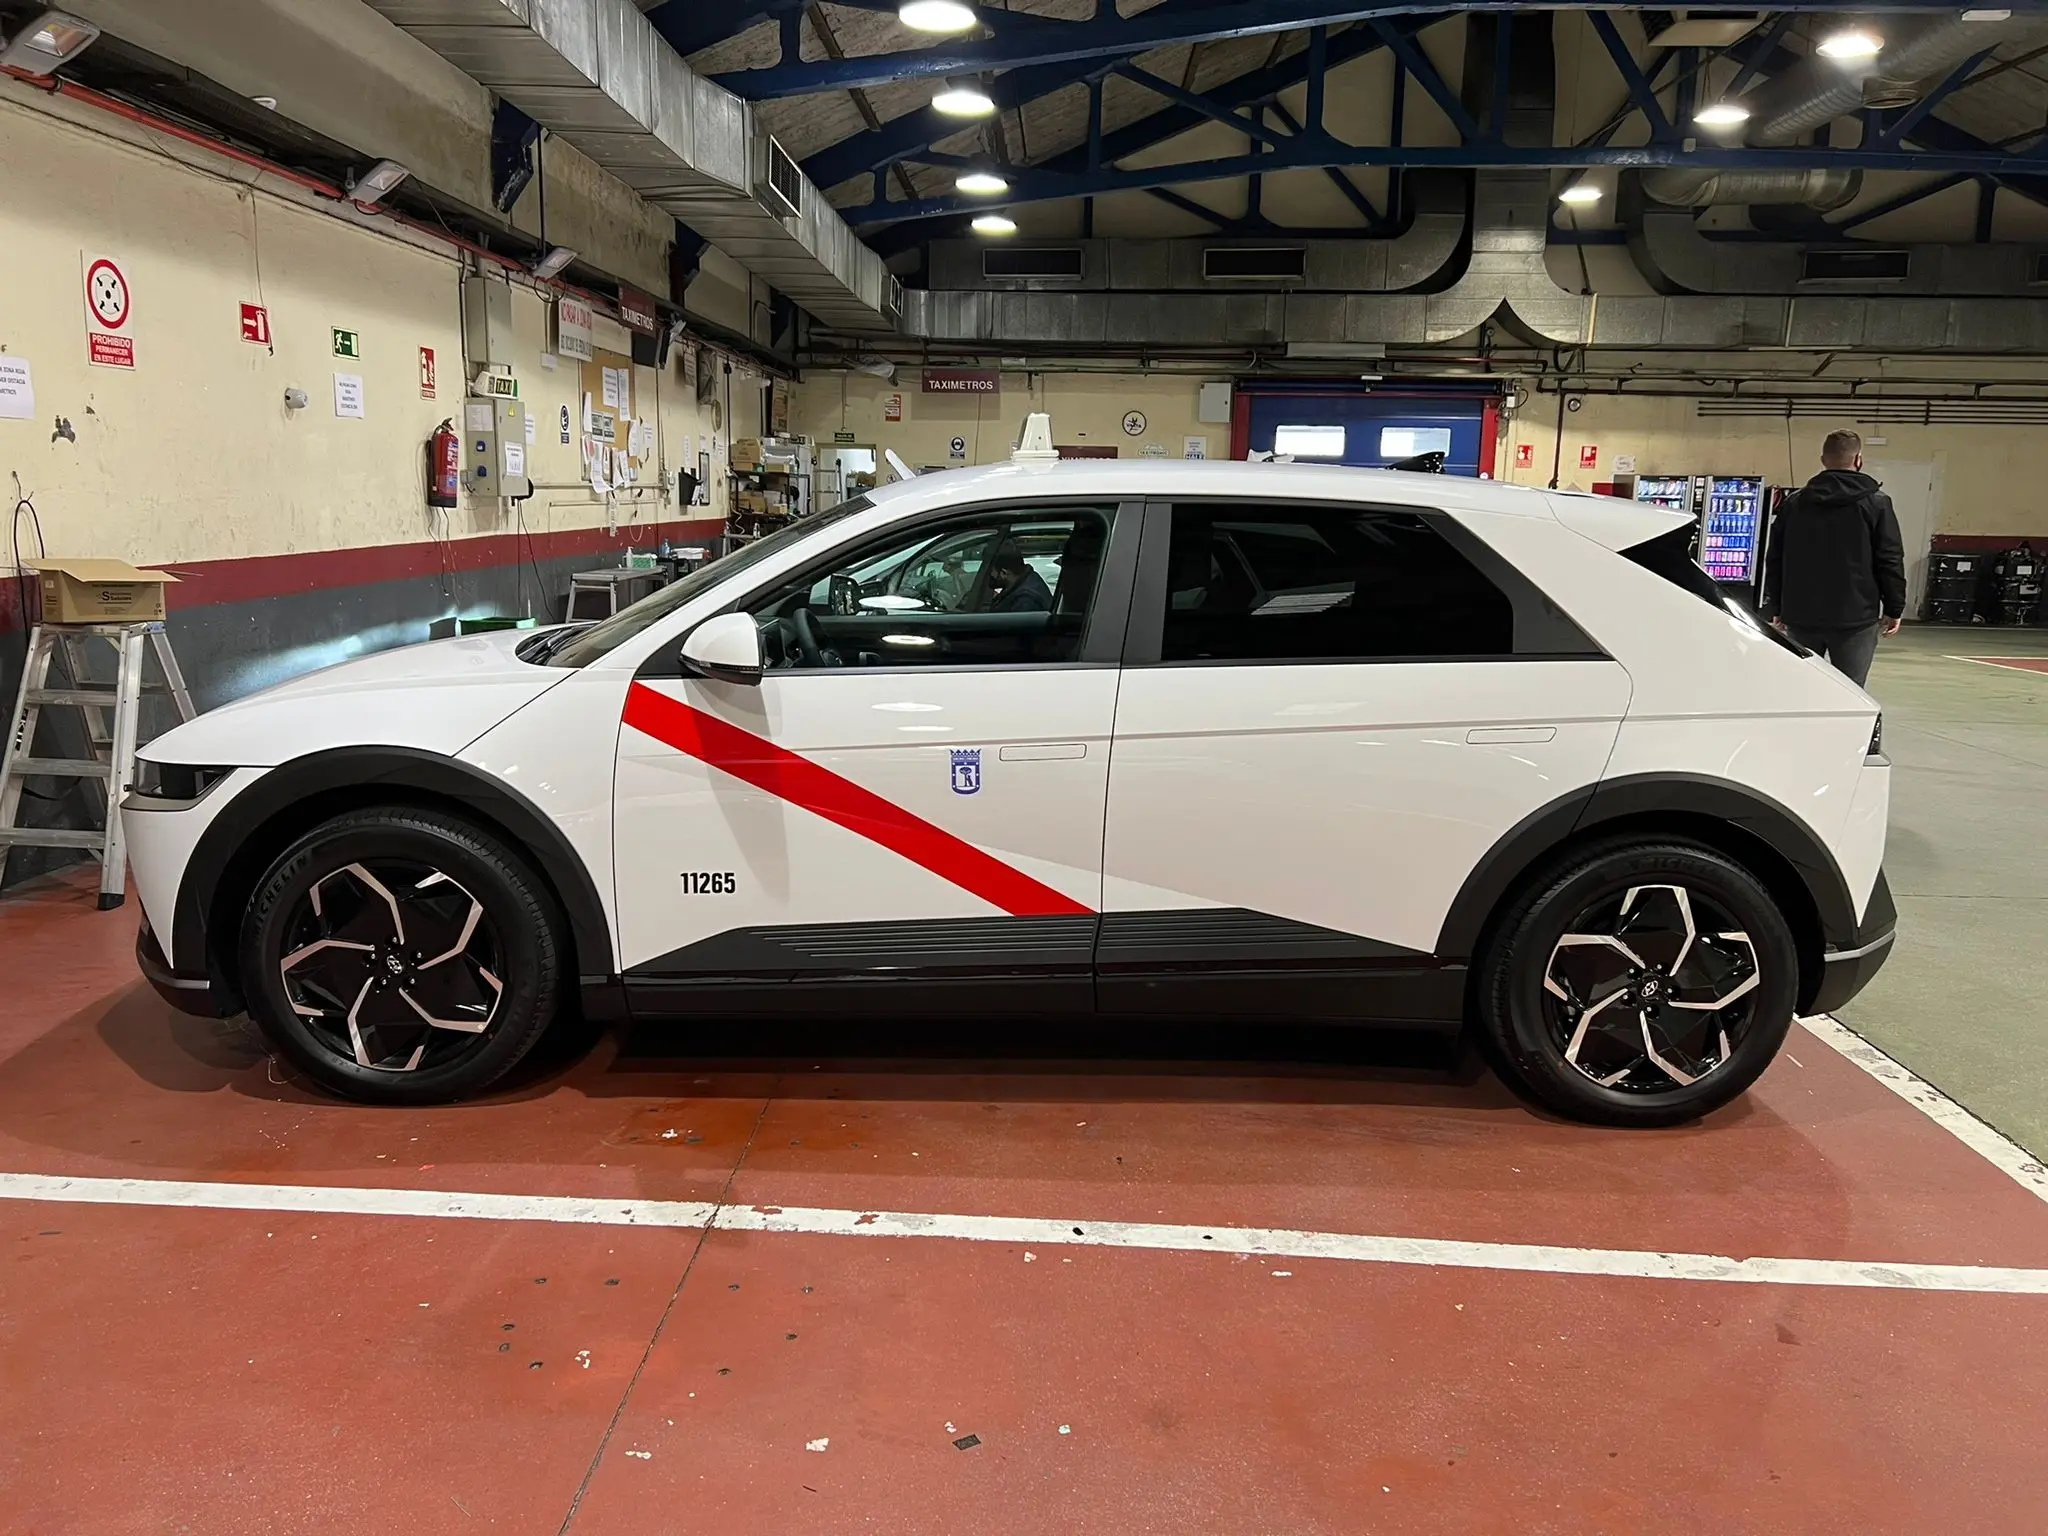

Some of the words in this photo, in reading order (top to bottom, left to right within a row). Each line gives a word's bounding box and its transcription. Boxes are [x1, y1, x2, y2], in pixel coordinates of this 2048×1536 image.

[621, 306, 654, 330] TAXIMETROS
[92, 334, 131, 349] PROHIBIDO
[95, 344, 129, 357] PERMANECER
[93, 353, 101, 361] EN
[101, 354, 115, 363] ESTE
[115, 356, 132, 365] LUGAR
[497, 380, 512, 393] TAXI
[929, 380, 993, 390] TAXIMETROS
[680, 872, 736, 894] 11265
